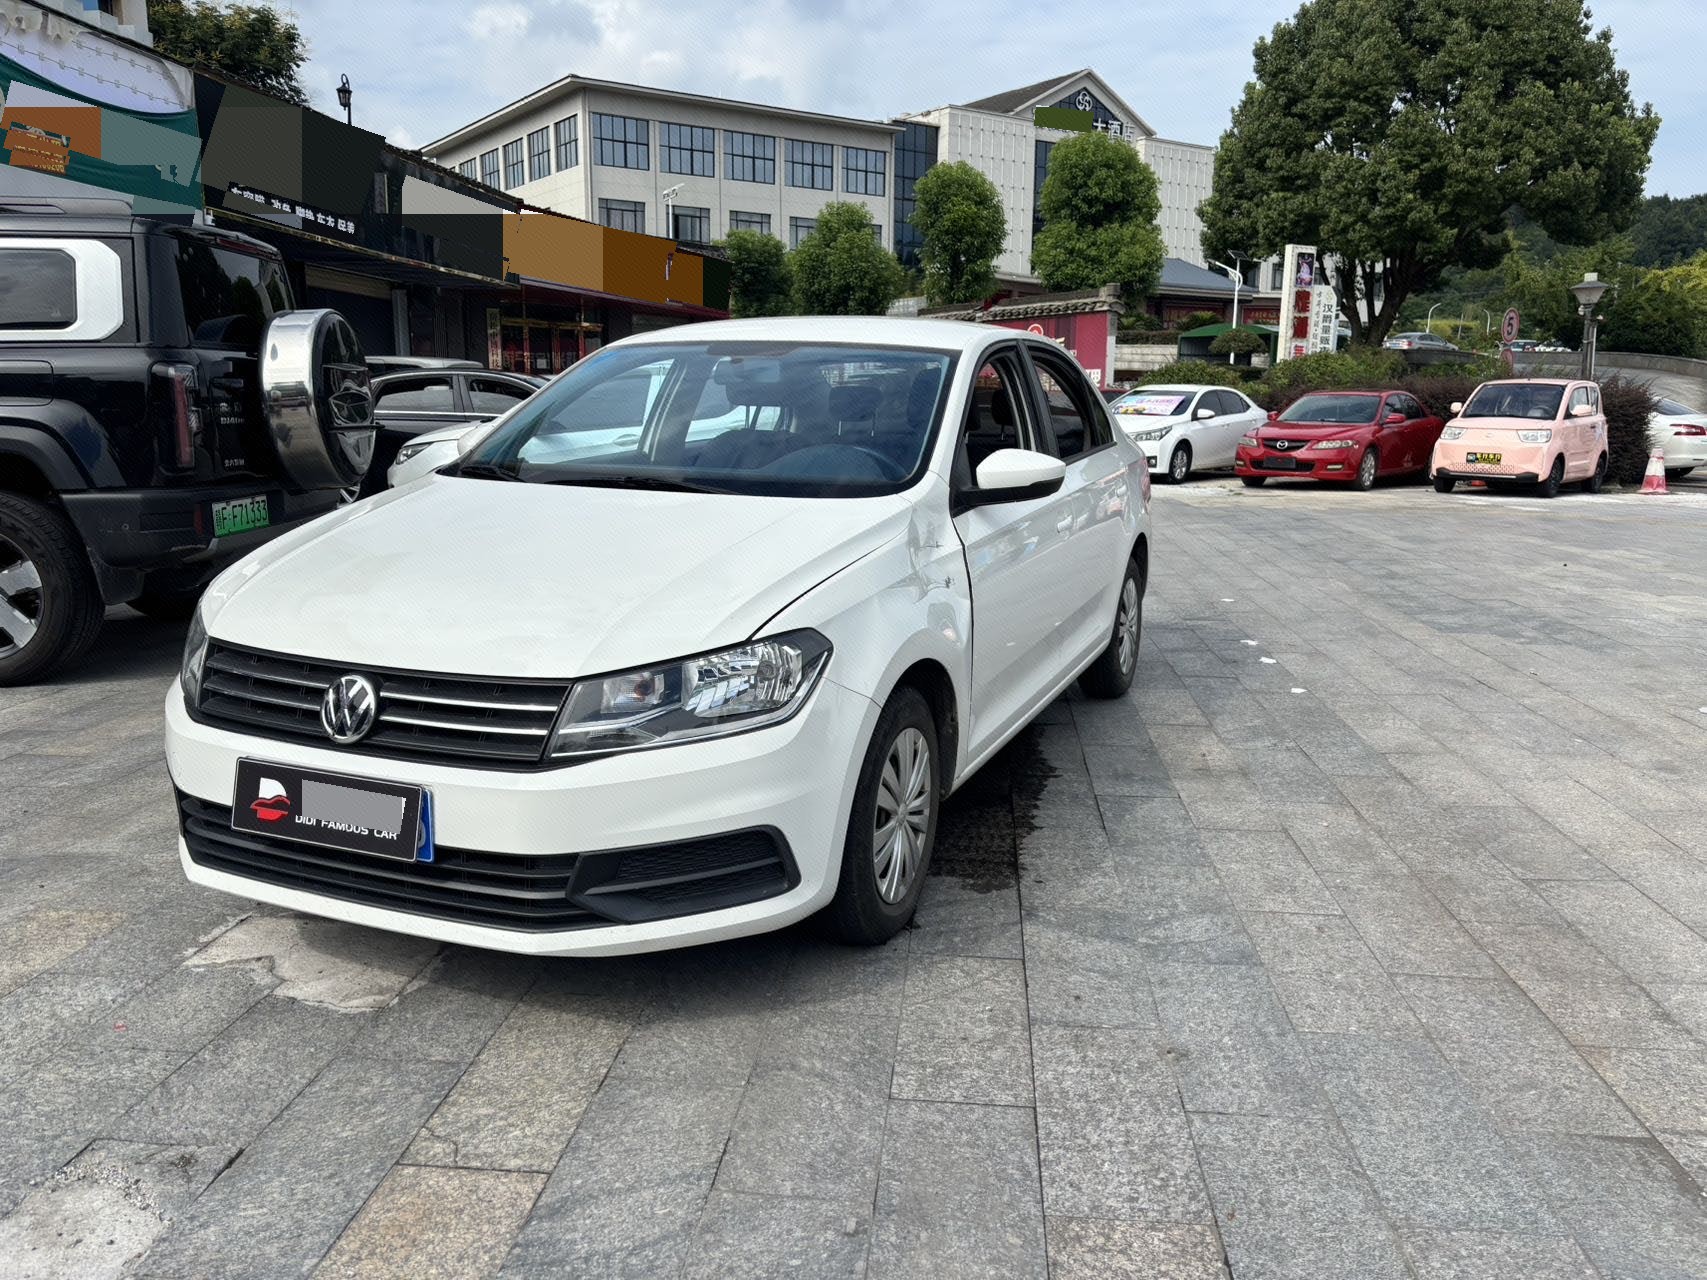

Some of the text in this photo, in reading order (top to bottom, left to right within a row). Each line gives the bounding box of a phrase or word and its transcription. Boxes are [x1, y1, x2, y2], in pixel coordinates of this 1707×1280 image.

[1506, 316, 1515, 336] 5
[321, 820, 369, 835] FAMOUS
[374, 829, 397, 840] CAR
